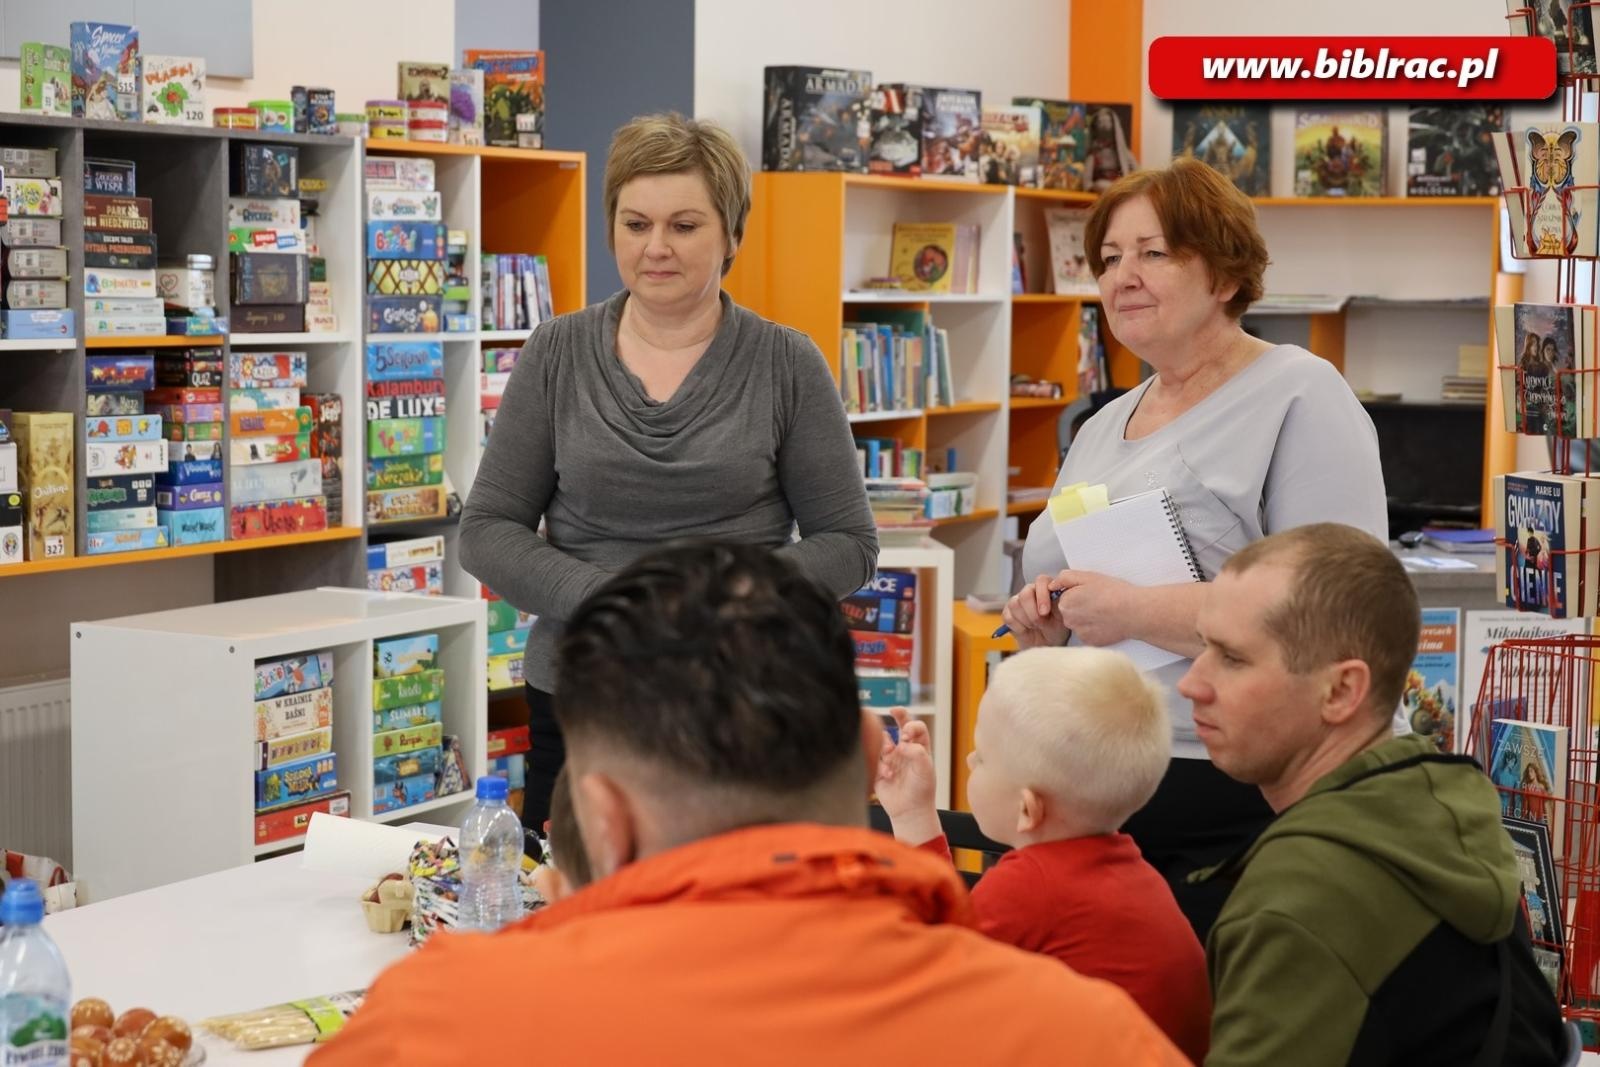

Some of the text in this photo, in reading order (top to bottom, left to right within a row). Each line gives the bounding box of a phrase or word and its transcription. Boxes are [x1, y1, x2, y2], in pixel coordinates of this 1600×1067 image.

[118, 82, 134, 92] 515
[185, 110, 204, 121] 120
[106, 206, 126, 216] PARK
[191, 371, 211, 387] QUIZ
[367, 396, 445, 420] DE LUXE
[1535, 485, 1561, 497] MARIE LU
[1508, 494, 1562, 534] GWIAZDY
[47, 545, 64, 556] 327
